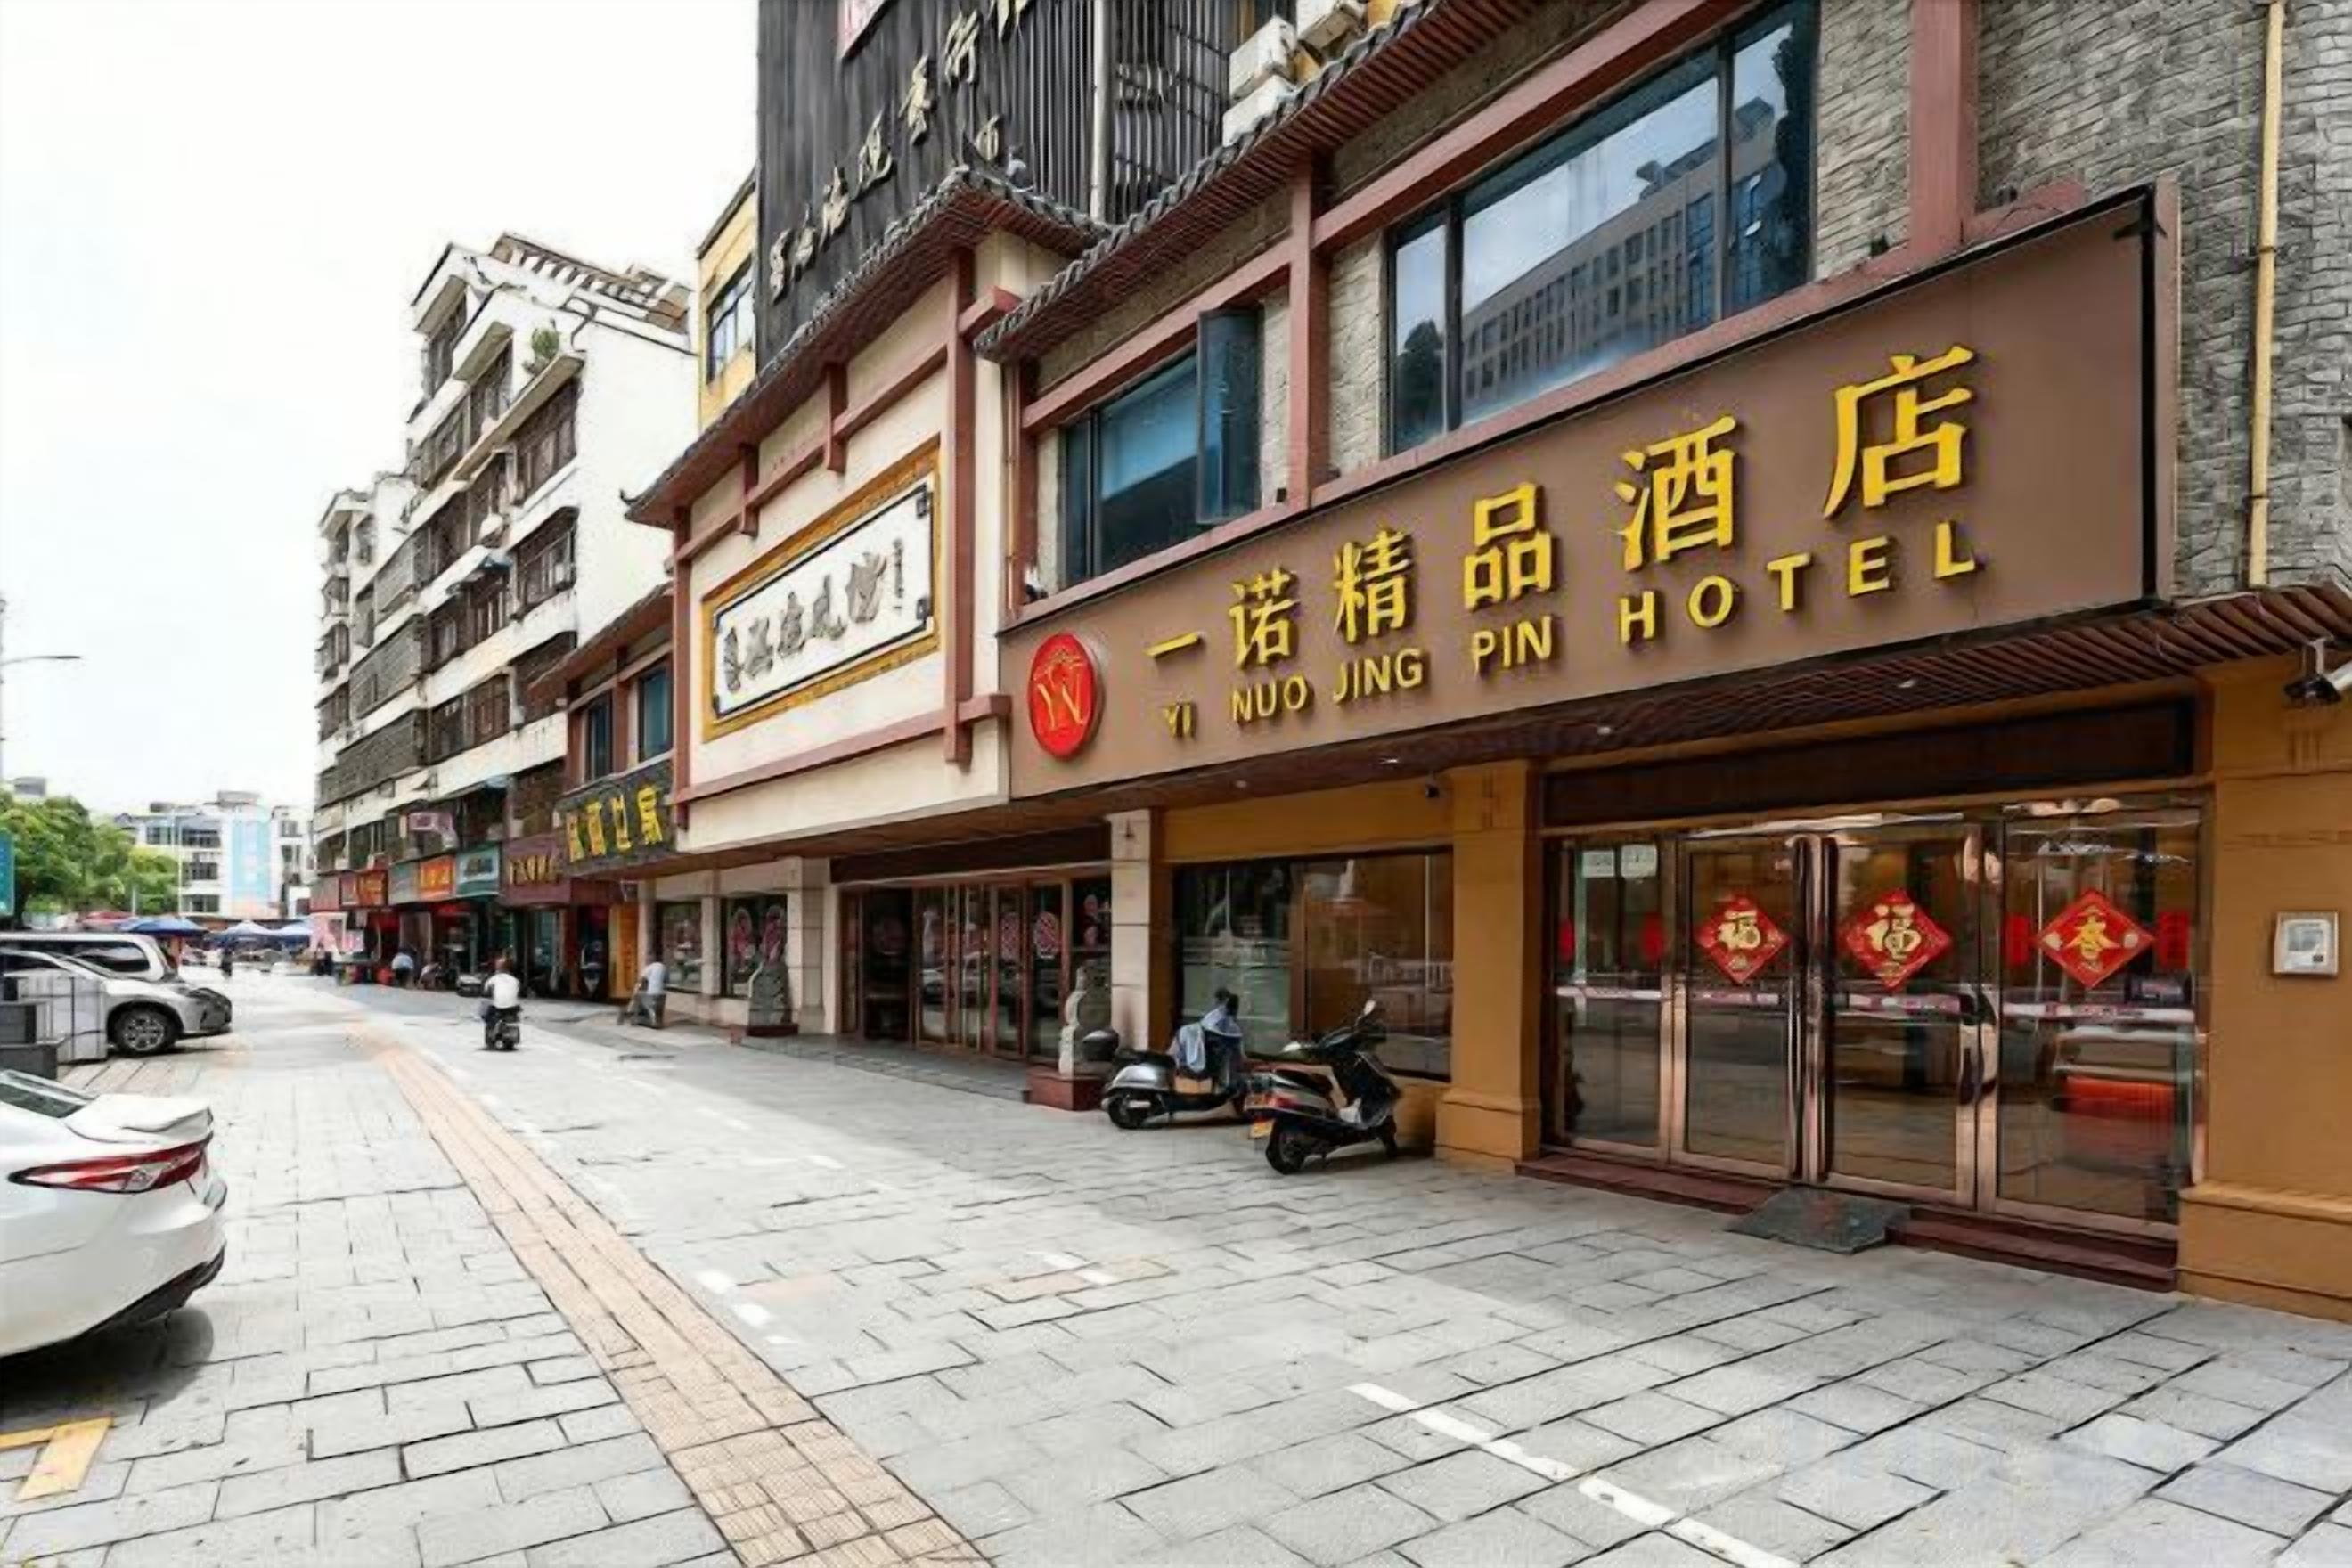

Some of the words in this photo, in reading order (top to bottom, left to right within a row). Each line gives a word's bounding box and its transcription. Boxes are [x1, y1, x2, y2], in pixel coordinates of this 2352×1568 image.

[1148, 345, 1976, 674] 一诺精品酒店
[1164, 701, 1192, 738] YI
[1229, 671, 1309, 723] NUO
[1333, 646, 1423, 704] JING
[1468, 613, 1555, 675] PIN
[1615, 521, 1976, 649] HOTEL
